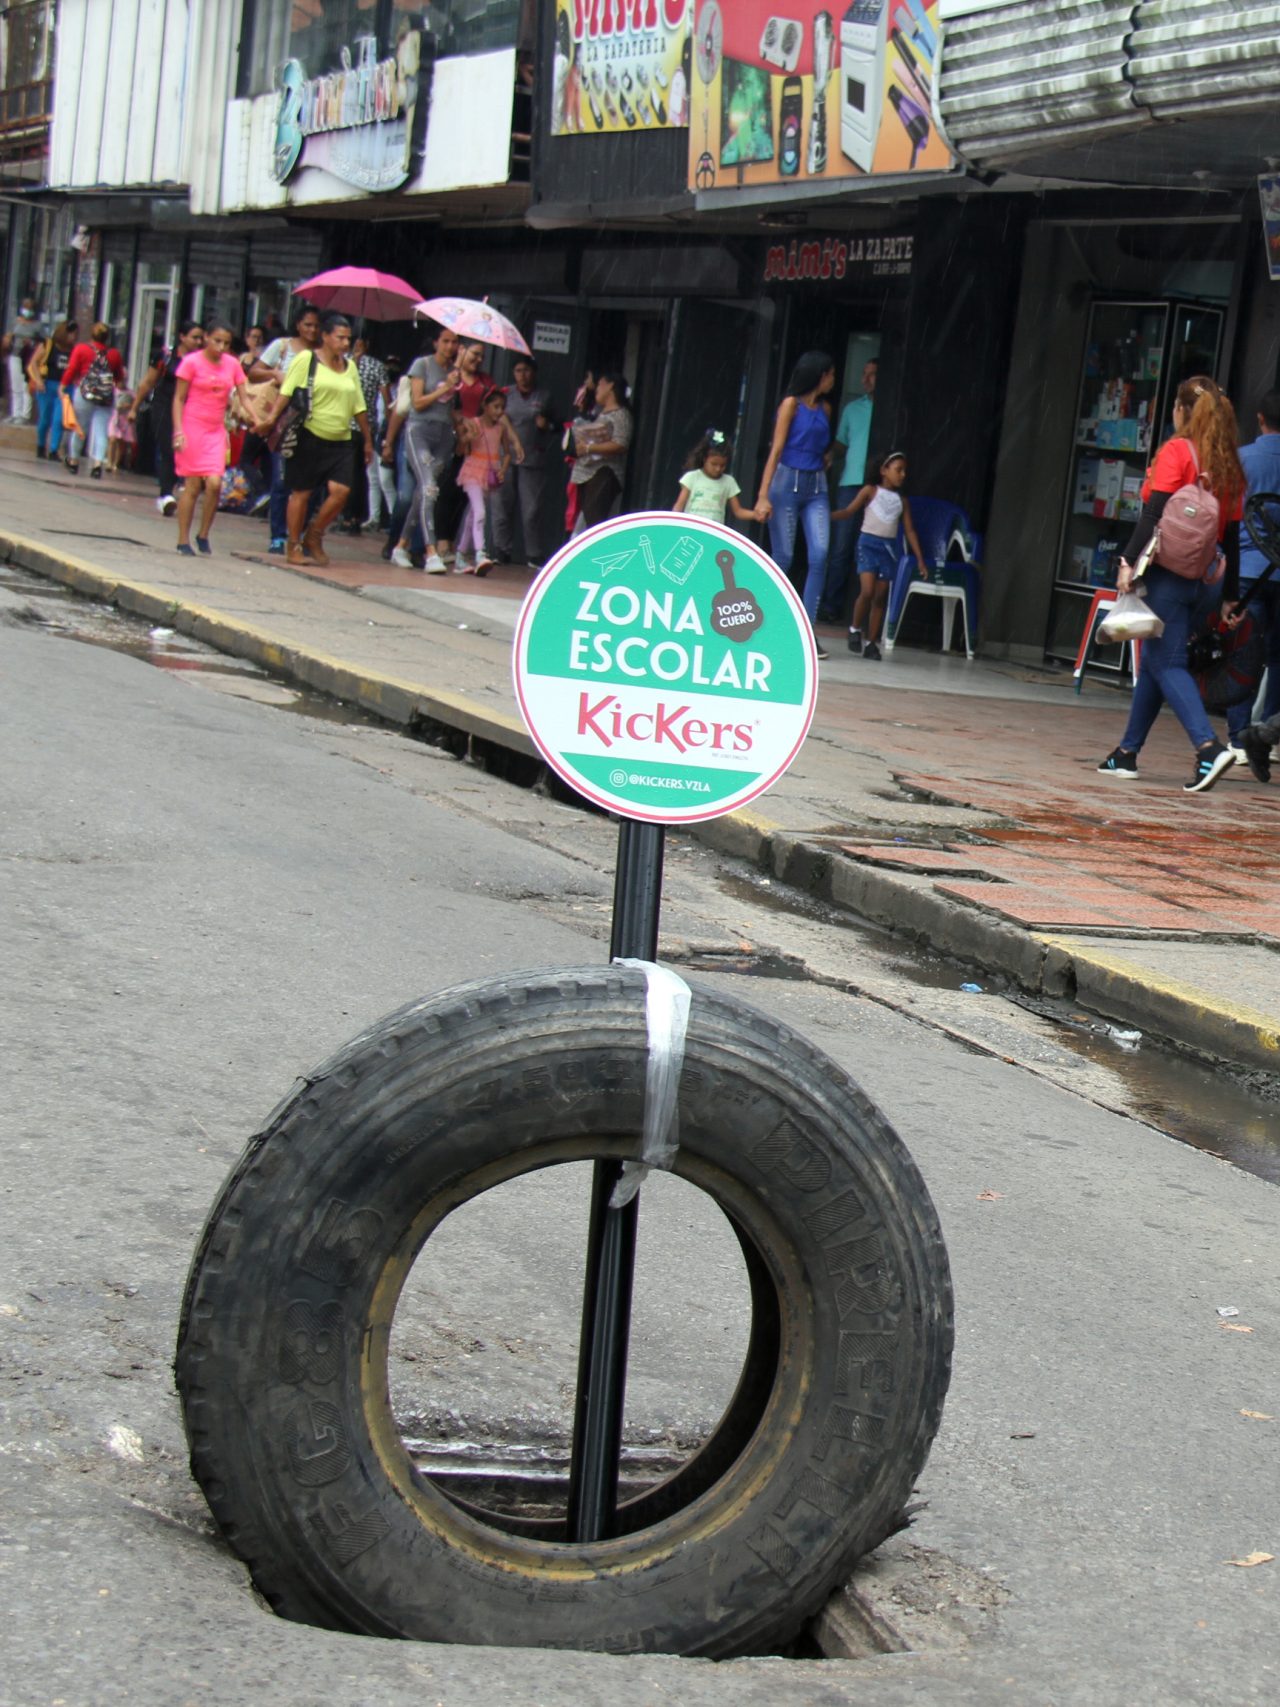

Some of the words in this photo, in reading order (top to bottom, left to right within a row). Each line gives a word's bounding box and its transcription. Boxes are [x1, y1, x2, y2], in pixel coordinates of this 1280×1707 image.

[848, 239, 863, 261] LA
[575, 581, 704, 635] ZONA
[717, 601, 753, 617] 100%
[719, 613, 756, 628] CUERO
[569, 630, 771, 692] ESCOLAR
[629, 774, 711, 793] @KICKERS.VZLA
[745, 1114, 898, 1588] PIRELLI
